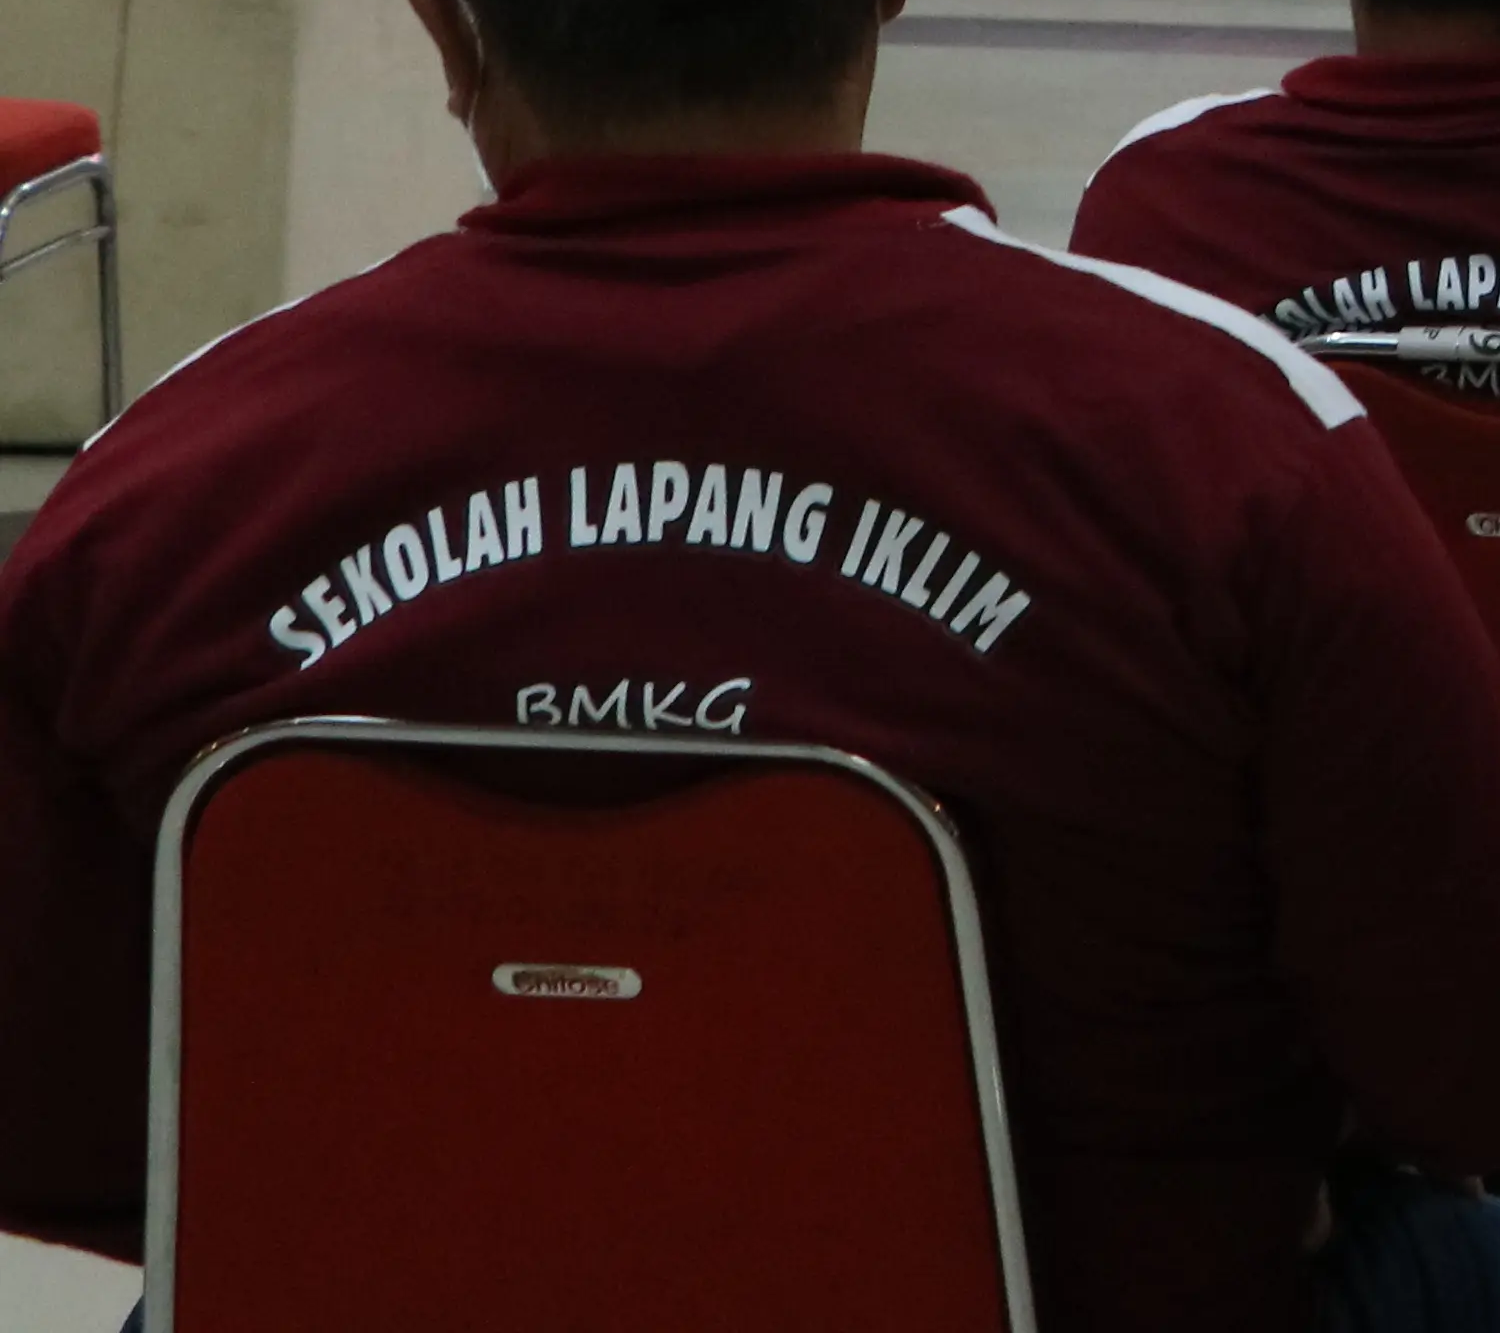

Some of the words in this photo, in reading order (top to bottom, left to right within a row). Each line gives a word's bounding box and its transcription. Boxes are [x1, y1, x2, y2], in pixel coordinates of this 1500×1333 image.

[270, 476, 543, 671] SEKOLAH
[570, 460, 833, 564] LAPANG
[840, 499, 1031, 653] IKLIM
[516, 677, 752, 734] BMKG
